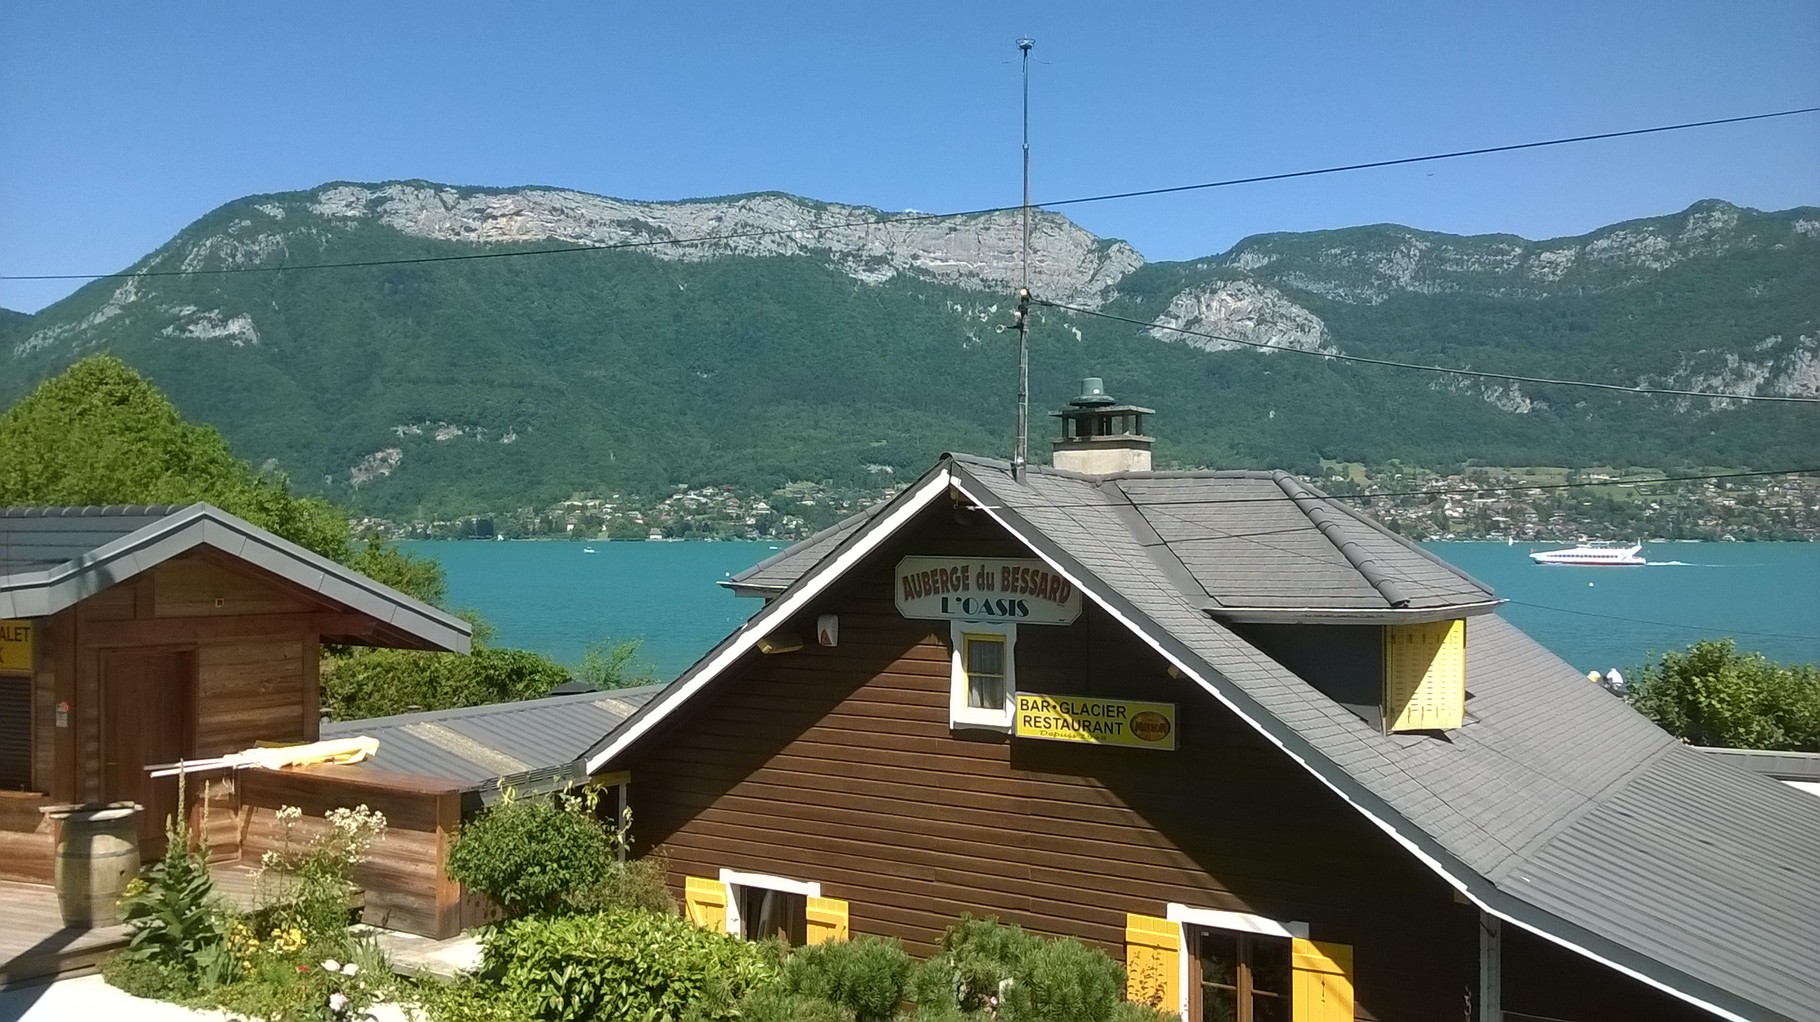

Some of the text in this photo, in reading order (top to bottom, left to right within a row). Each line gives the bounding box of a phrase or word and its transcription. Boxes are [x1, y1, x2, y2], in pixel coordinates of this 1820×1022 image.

[901, 564, 1072, 604] AUBERGE du BESSARD
[941, 597, 1029, 617] L'OASIS
[1023, 715, 1123, 735] RESTAURANT
